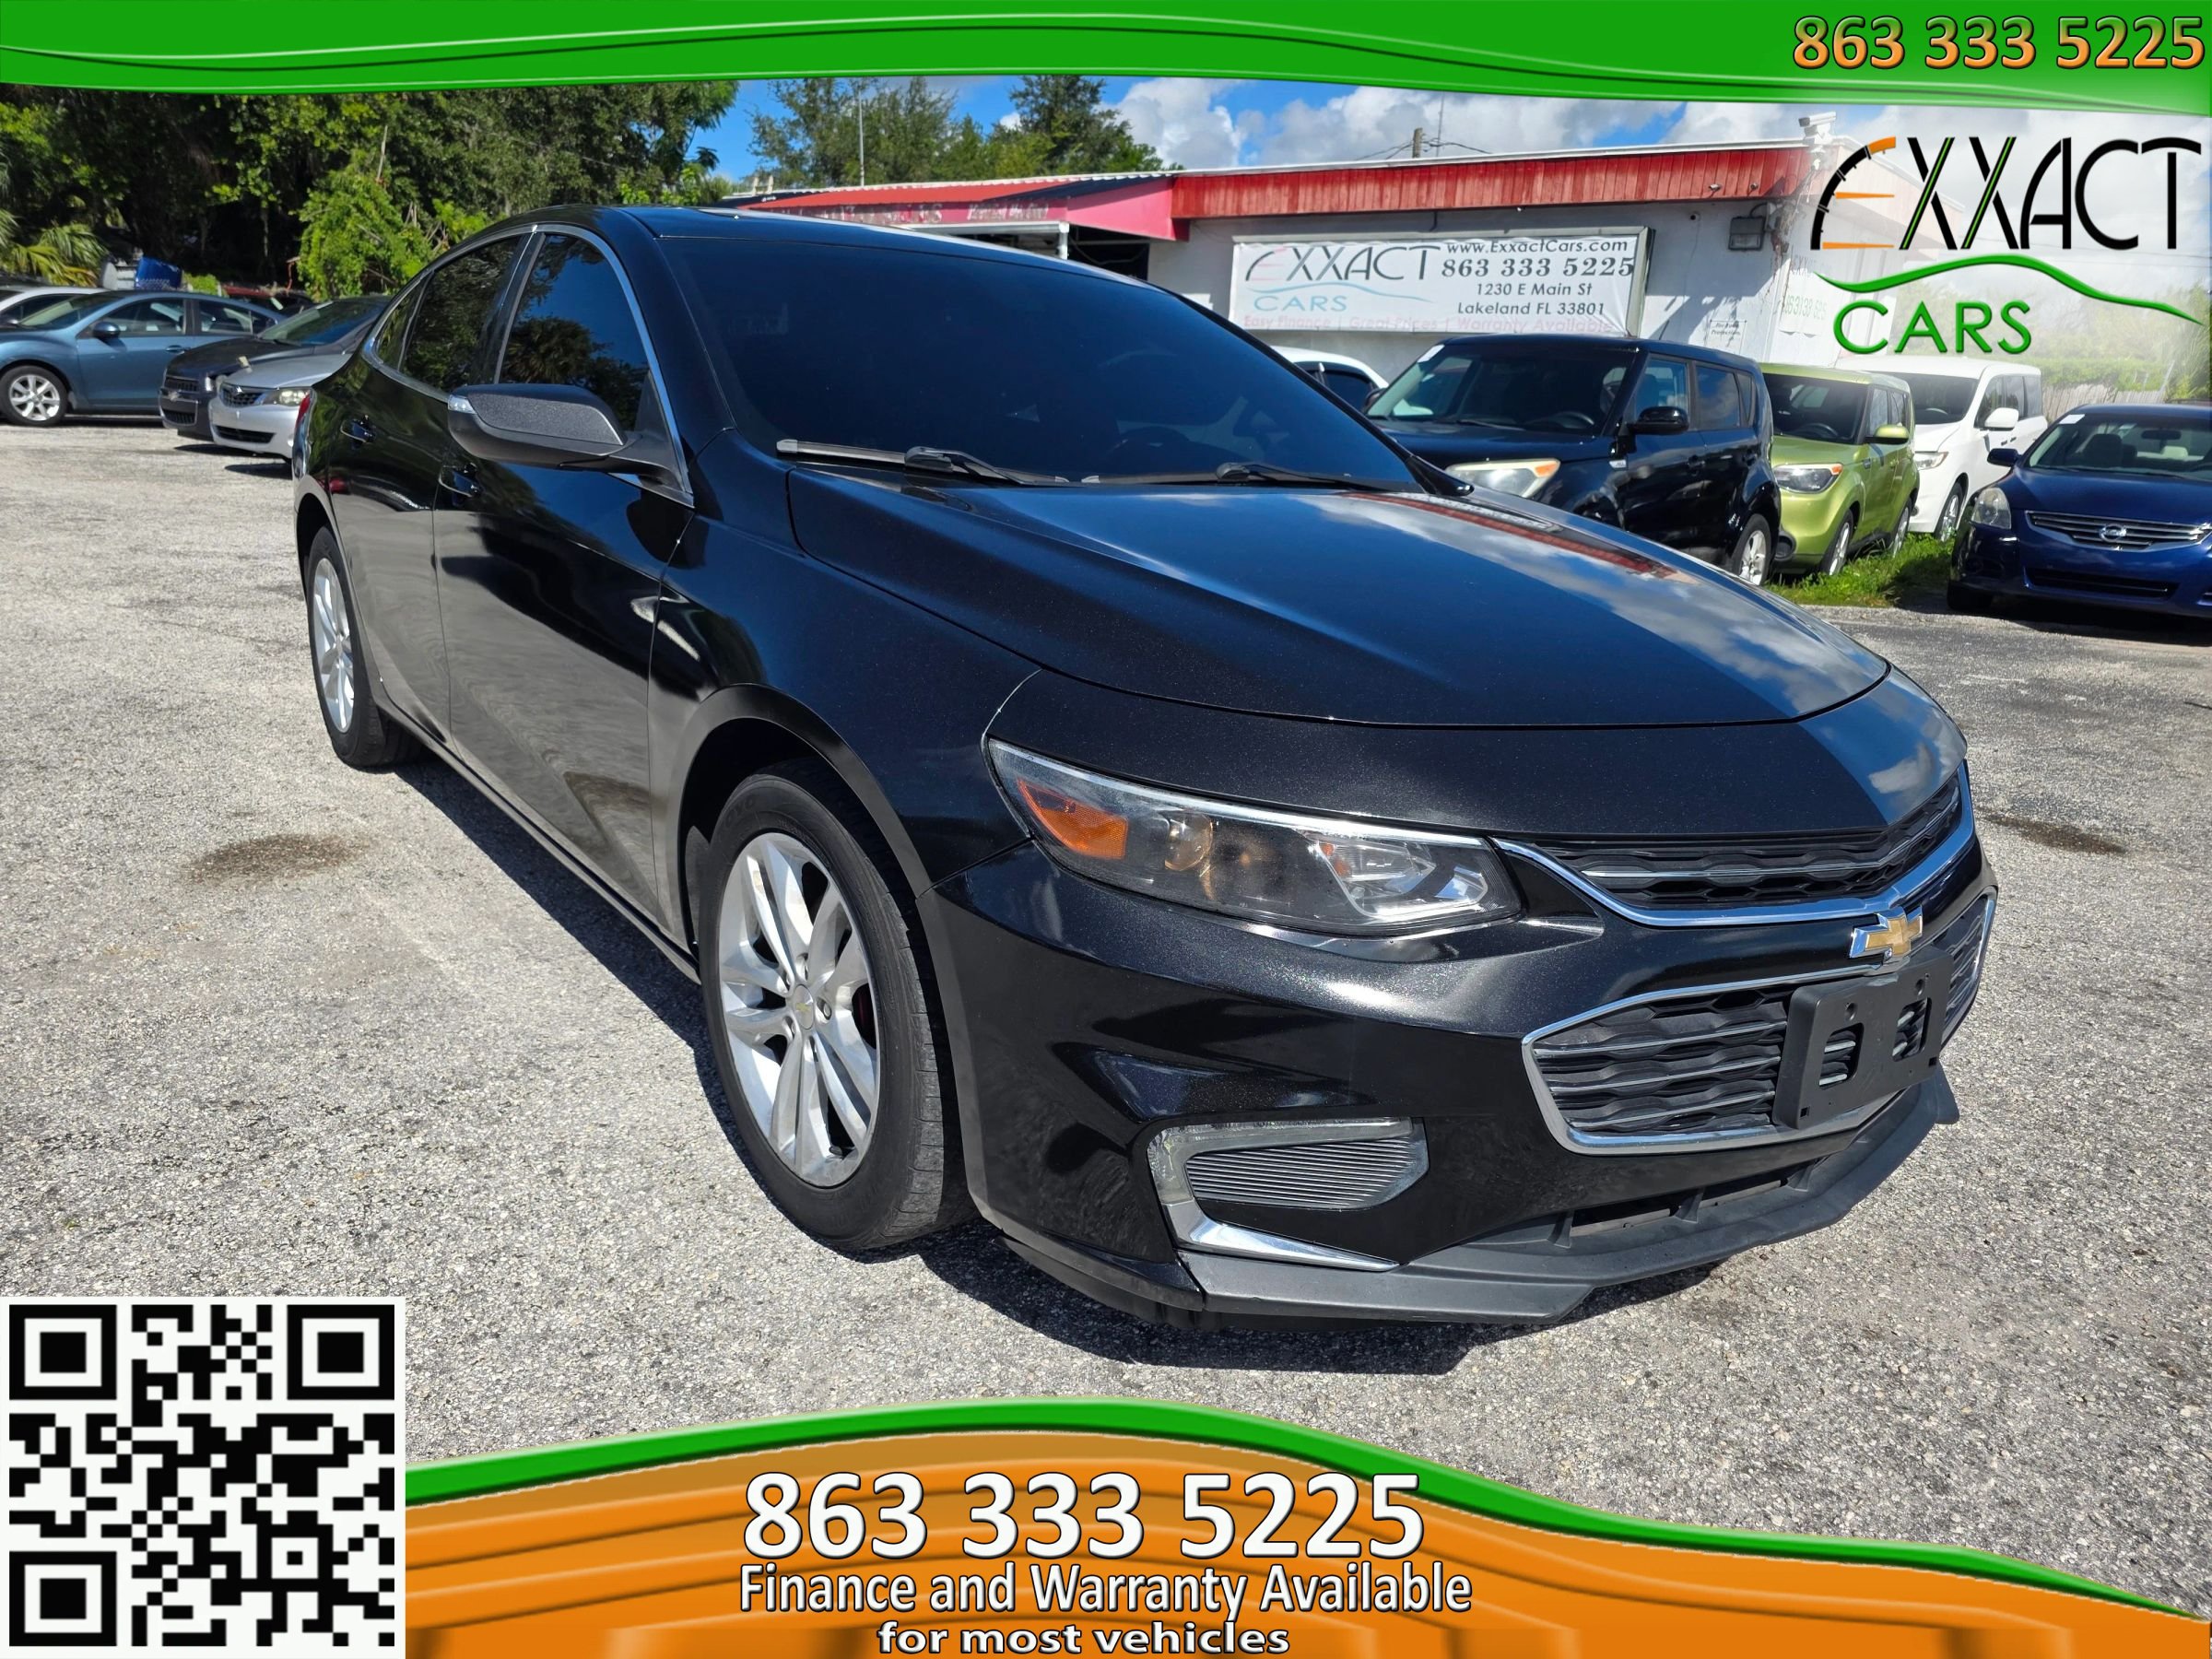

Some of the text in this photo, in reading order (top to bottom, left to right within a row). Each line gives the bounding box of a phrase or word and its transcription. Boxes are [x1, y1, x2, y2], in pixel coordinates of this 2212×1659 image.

[1447, 239, 1628, 253] www.ExxactCars.com
[1245, 245, 1441, 281] EXXACT
[1441, 257, 1634, 276] 863 333 5225
[1477, 282, 1593, 295] 1230 E Main St
[1253, 295, 1347, 312] CARS
[1458, 301, 1605, 315] Lakeland FL 33801
[1244, 315, 1614, 333] Easy Finance Great Prices Warranty Available
